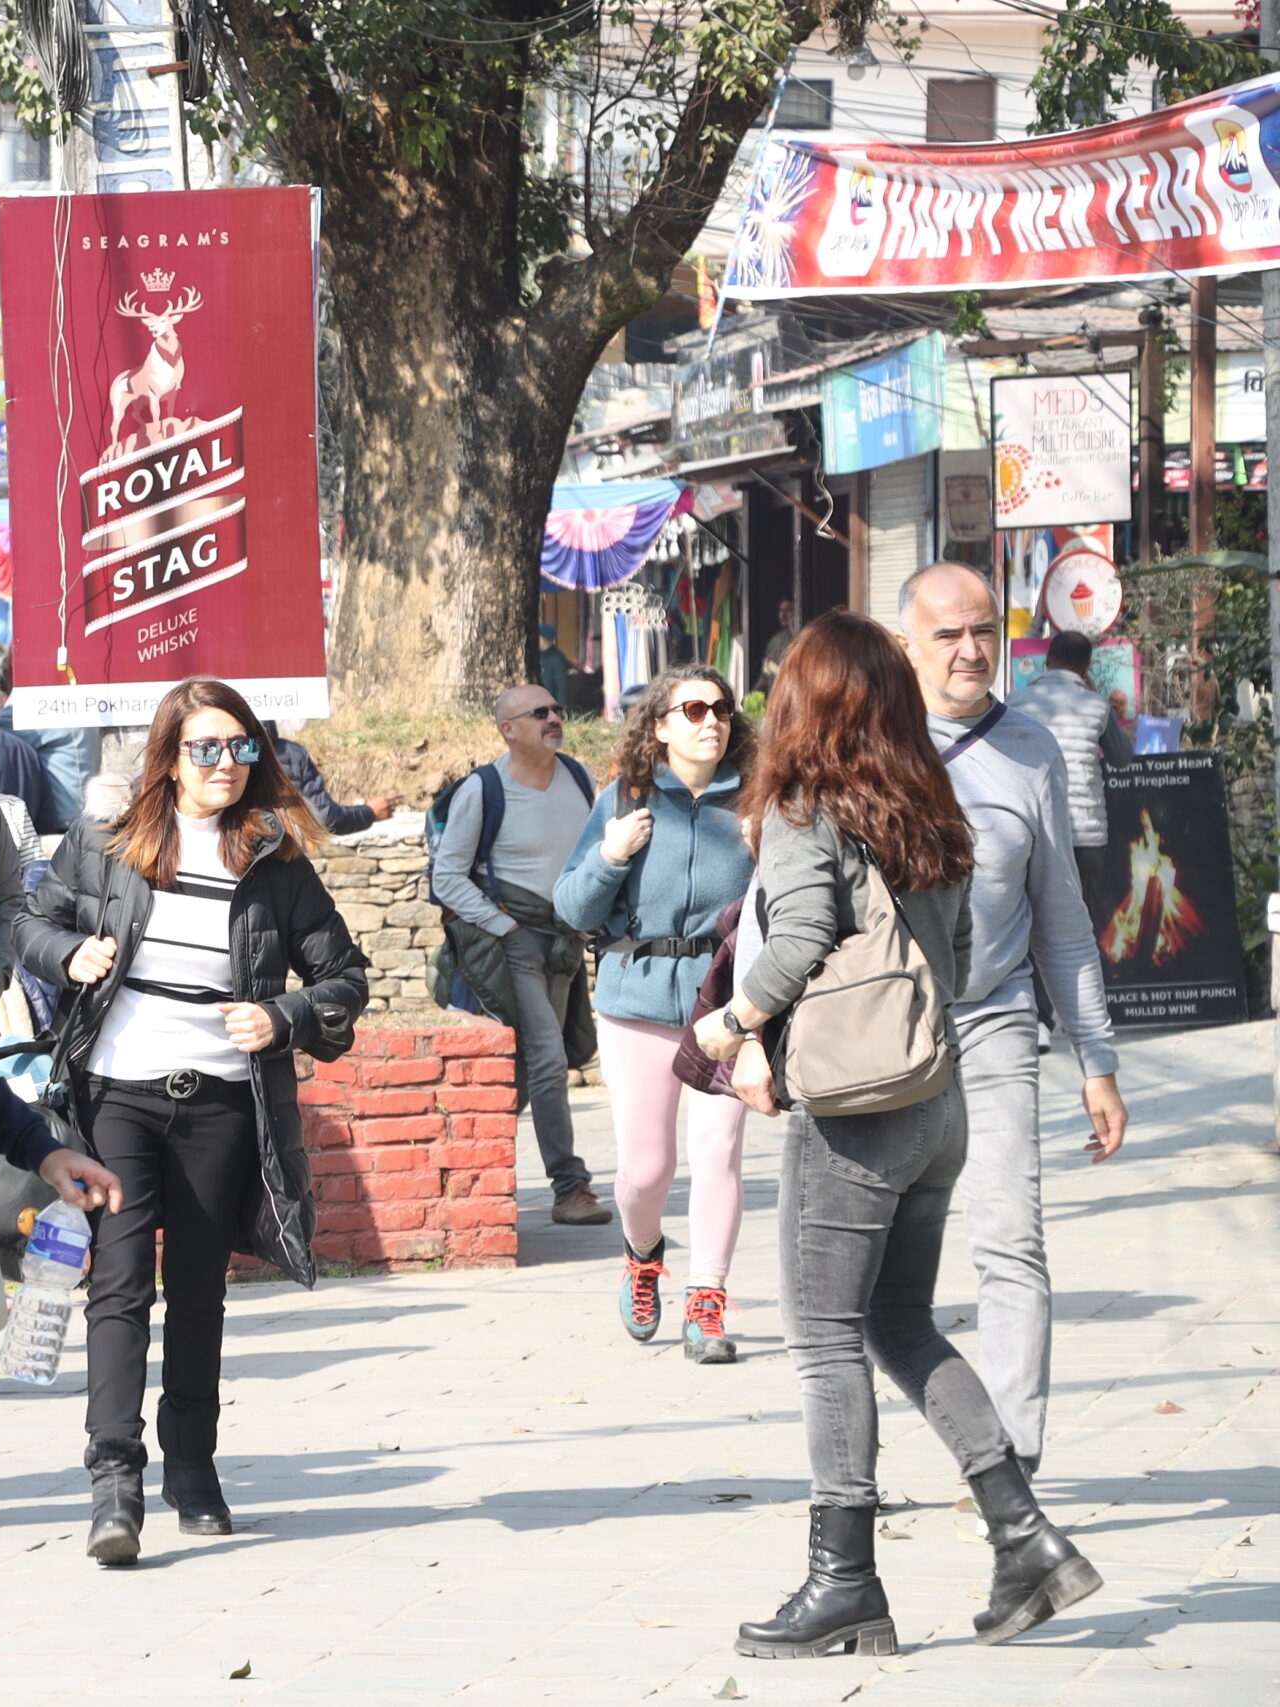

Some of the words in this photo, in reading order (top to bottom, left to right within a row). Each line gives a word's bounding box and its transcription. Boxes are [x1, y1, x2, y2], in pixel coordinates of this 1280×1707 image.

[882, 168, 1004, 260] HAPPY
[1007, 164, 1097, 252] NEW
[1092, 147, 1217, 245] YEAR
[82, 229, 230, 250] SEAGRAM'S
[96, 438, 233, 517] ROYAL
[112, 533, 219, 602] STAG
[137, 607, 198, 644] DELUXE
[137, 628, 200, 663] WHISKY
[37, 699, 77, 715] 24th
[85, 696, 159, 713] Pokhara
[242, 690, 300, 708] estival
[1146, 760, 1176, 771] Your
[1178, 757, 1214, 769] Heart
[1109, 778, 1132, 789] Our
[1134, 775, 1191, 788] Fireplace
[1106, 993, 1139, 1003] PLACE
[1151, 991, 1173, 1001] HOT
[1175, 989, 1199, 1000] RUM
[1201, 987, 1237, 999] PUNCH
[1125, 1007, 1167, 1017] MULLED
[1168, 1004, 1197, 1015] WINE
